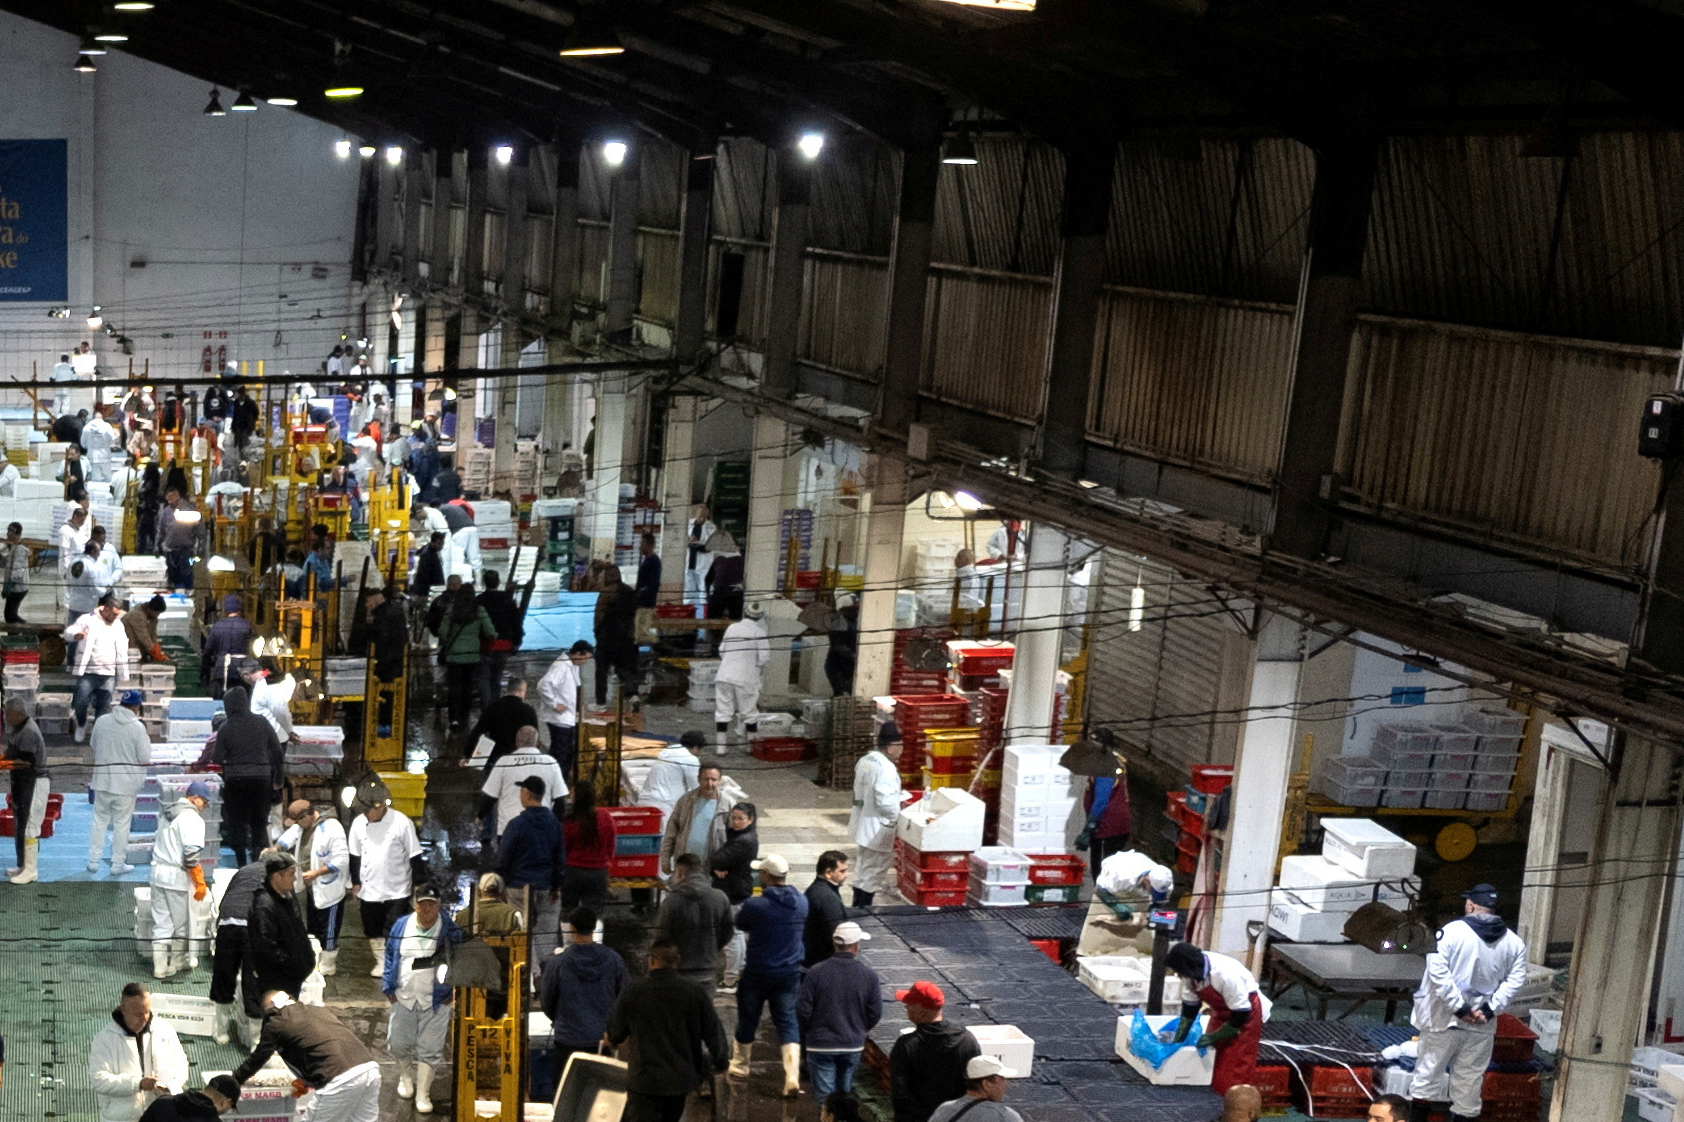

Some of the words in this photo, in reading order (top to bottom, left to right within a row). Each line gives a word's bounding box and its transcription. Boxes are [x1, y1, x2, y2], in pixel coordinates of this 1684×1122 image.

[466, 1024, 475, 1083] PESCA
[480, 1028, 497, 1039] 12
[502, 1026, 512, 1076] VIVA
